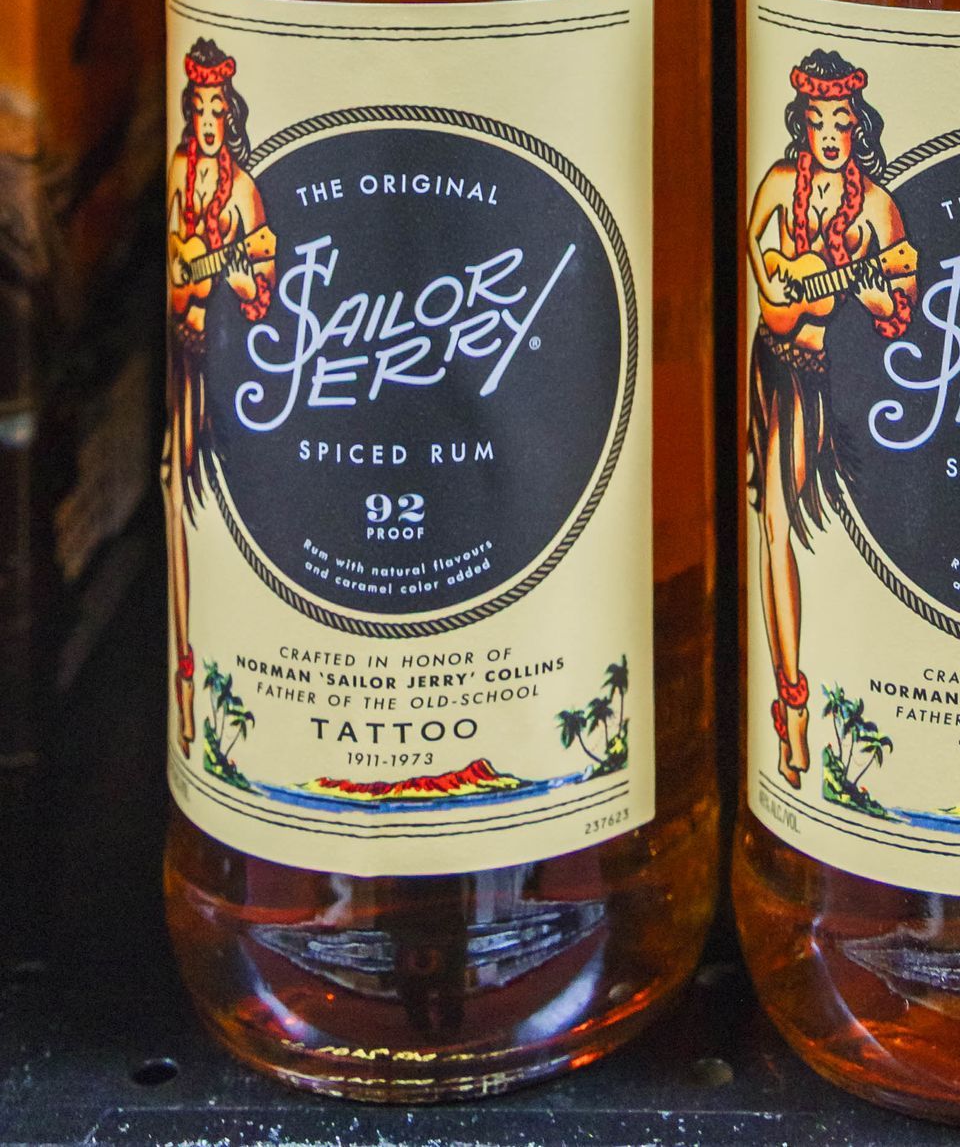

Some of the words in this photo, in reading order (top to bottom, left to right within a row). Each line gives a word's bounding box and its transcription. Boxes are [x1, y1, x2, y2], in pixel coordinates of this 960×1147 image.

[297, 179, 344, 206] THE
[360, 174, 498, 206] ORIGINAL
[248, 236, 526, 372] SAILOR
[300, 440, 407, 464] SPICED
[431, 441, 493, 463] RUM
[366, 494, 425, 522] 92
[367, 527, 424, 539] PROOF
[304, 539, 328, 560] Rum
[336, 558, 364, 574] with
[372, 563, 425, 577] natural
[434, 540, 493, 572] flavours
[305, 561, 329, 579] and
[335, 576, 392, 594] caramel
[400, 581, 439, 594] color
[447, 558, 491, 585] added
[236, 654, 311, 684] NORMAN
[485, 657, 565, 683] COLLINS
[279, 646, 355, 667] CRAFTED
[368, 654, 388, 668] IN
[402, 651, 475, 668] HONOR
[487, 647, 512, 664] OF
[256, 682, 317, 704] FATHER
[328, 694, 352, 708] OF
[364, 696, 397, 711] THE
[410, 683, 540, 710] OLD-SCHOOL
[870, 679, 959, 705] NORMAN
[310, 718, 478, 744] TATTOO
[348, 752, 433, 767] 1911-1973
[584, 808, 630, 836] 237623
